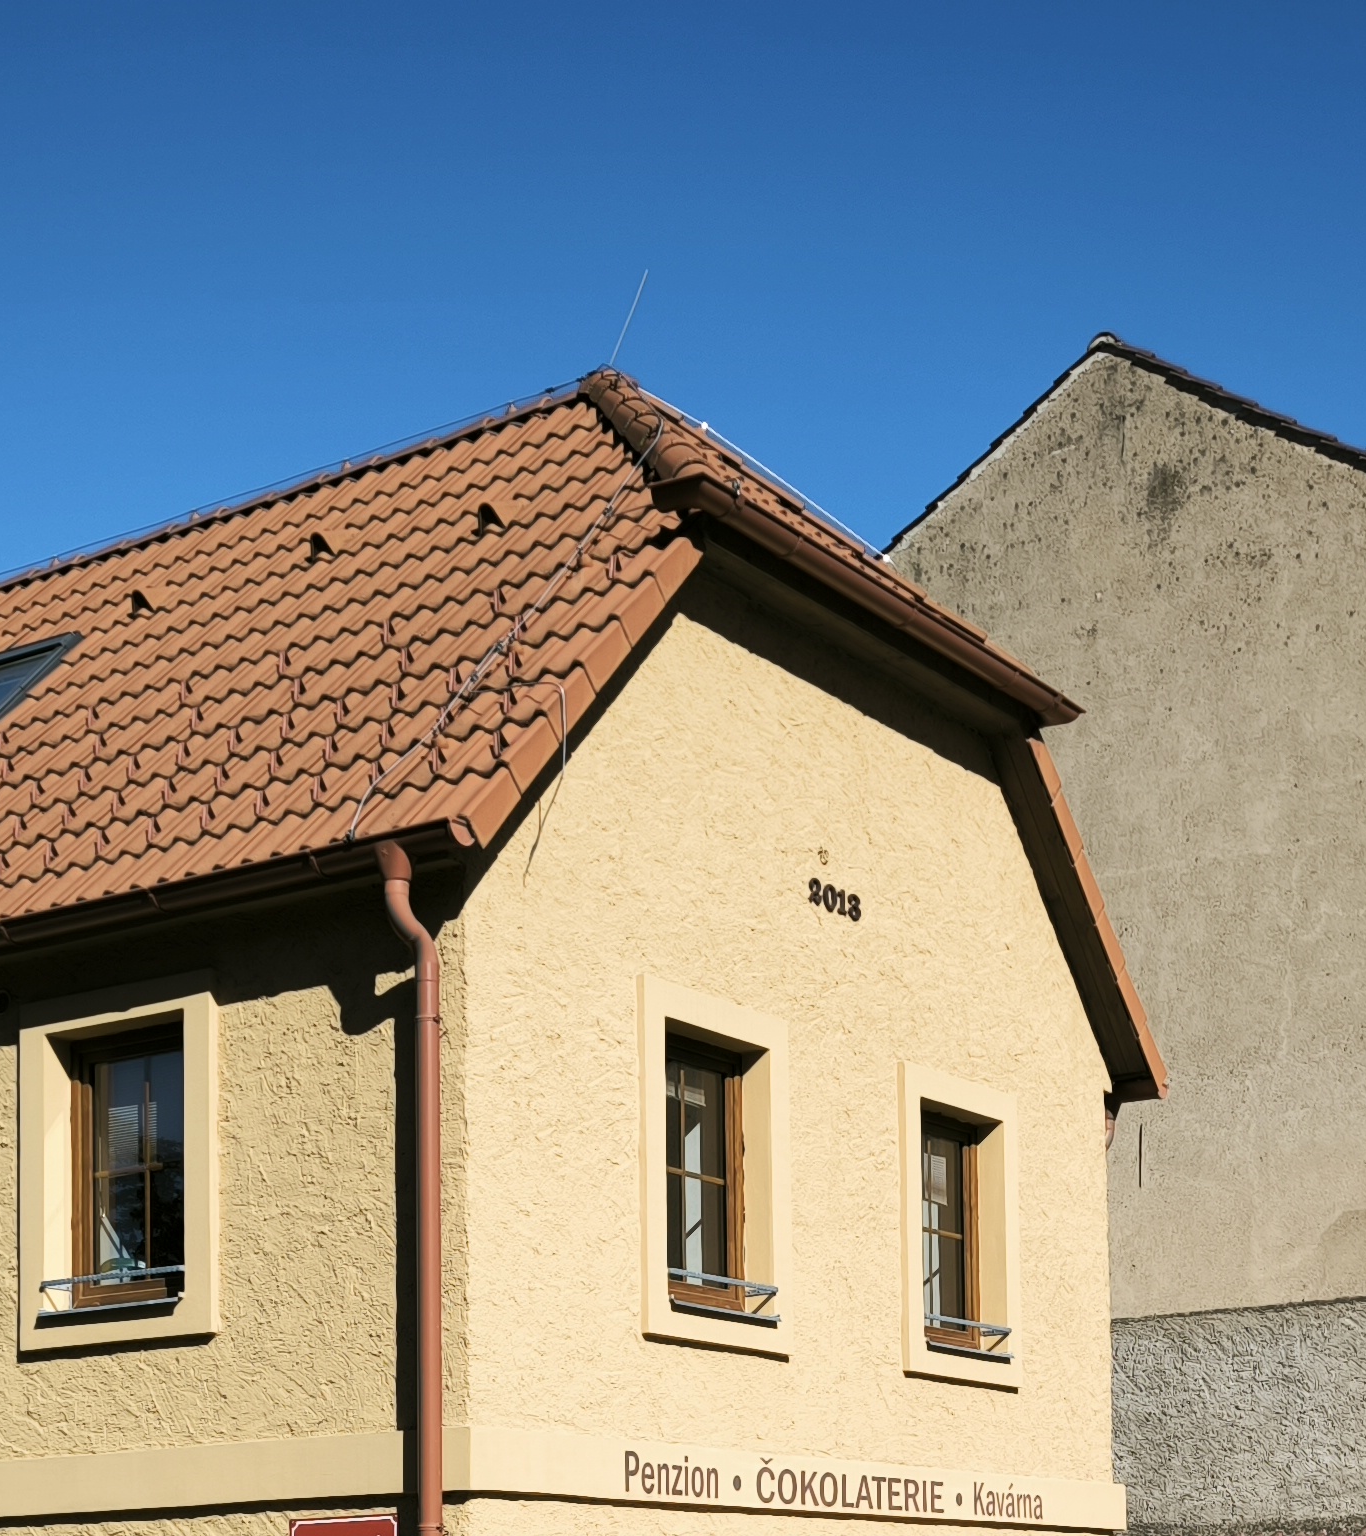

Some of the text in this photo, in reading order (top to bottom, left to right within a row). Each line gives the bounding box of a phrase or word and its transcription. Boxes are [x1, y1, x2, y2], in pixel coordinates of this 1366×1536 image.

[808, 877, 862, 922] 2013
[624, 1450, 1044, 1520] Penzion ČOKOLATERIE Kavárna
